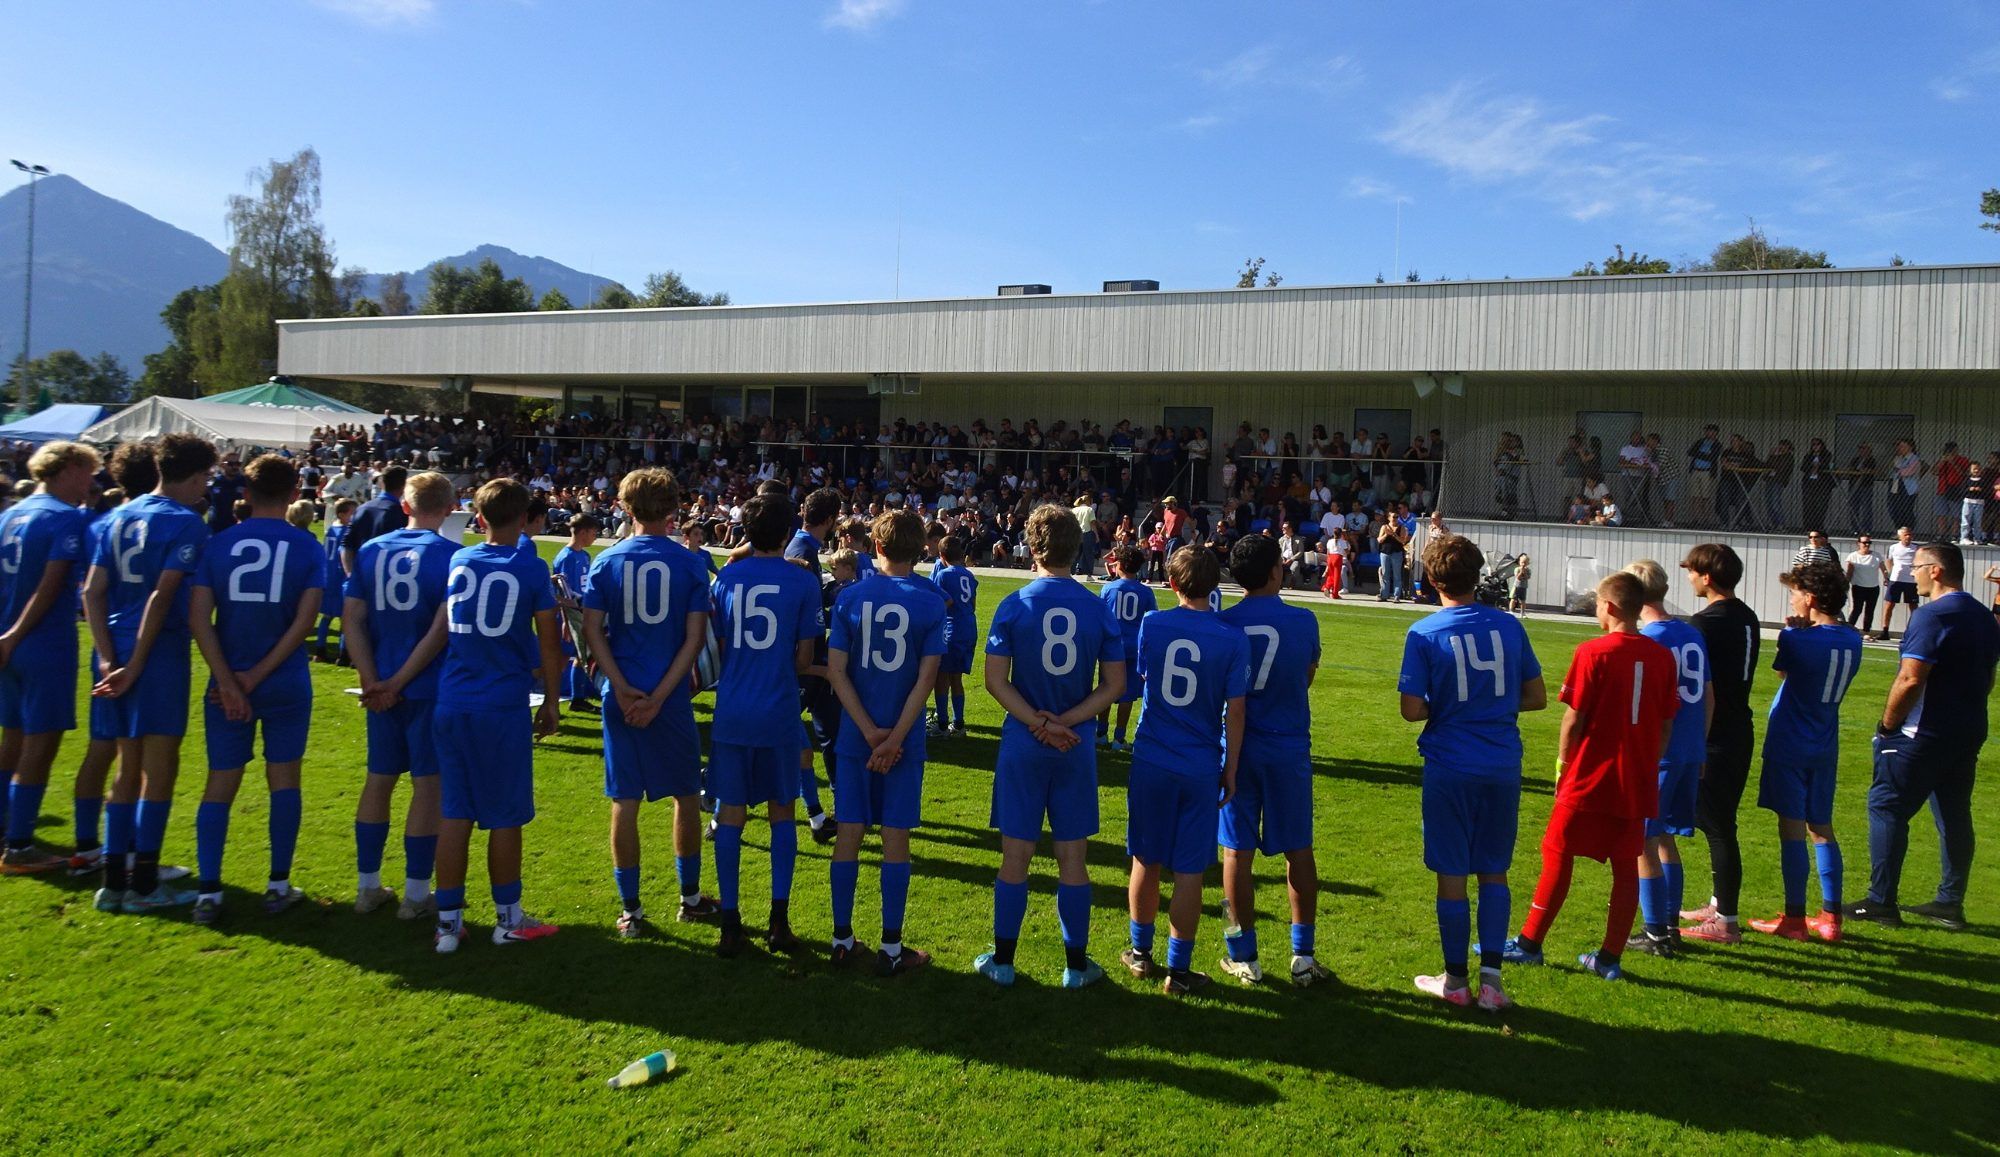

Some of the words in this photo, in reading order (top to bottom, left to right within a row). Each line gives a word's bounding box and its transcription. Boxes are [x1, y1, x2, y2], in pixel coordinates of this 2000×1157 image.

[1, 514, 32, 574] 5
[111, 517, 149, 583] 12
[229, 538, 289, 603] 21
[375, 549, 420, 611] 18
[447, 565, 520, 637] 20
[623, 560, 671, 625] 10
[959, 575, 972, 603] 9
[1116, 591, 1139, 621] 10
[733, 583, 778, 650] 15
[862, 601, 910, 672] 13
[1042, 607, 1077, 676] 8
[1161, 639, 1200, 707] 6
[1244, 624, 1280, 690] 7
[1449, 629, 1505, 702] 14
[1743, 625, 1752, 681] 1
[1821, 649, 1853, 703] 11
[1631, 661, 1644, 725] 1
